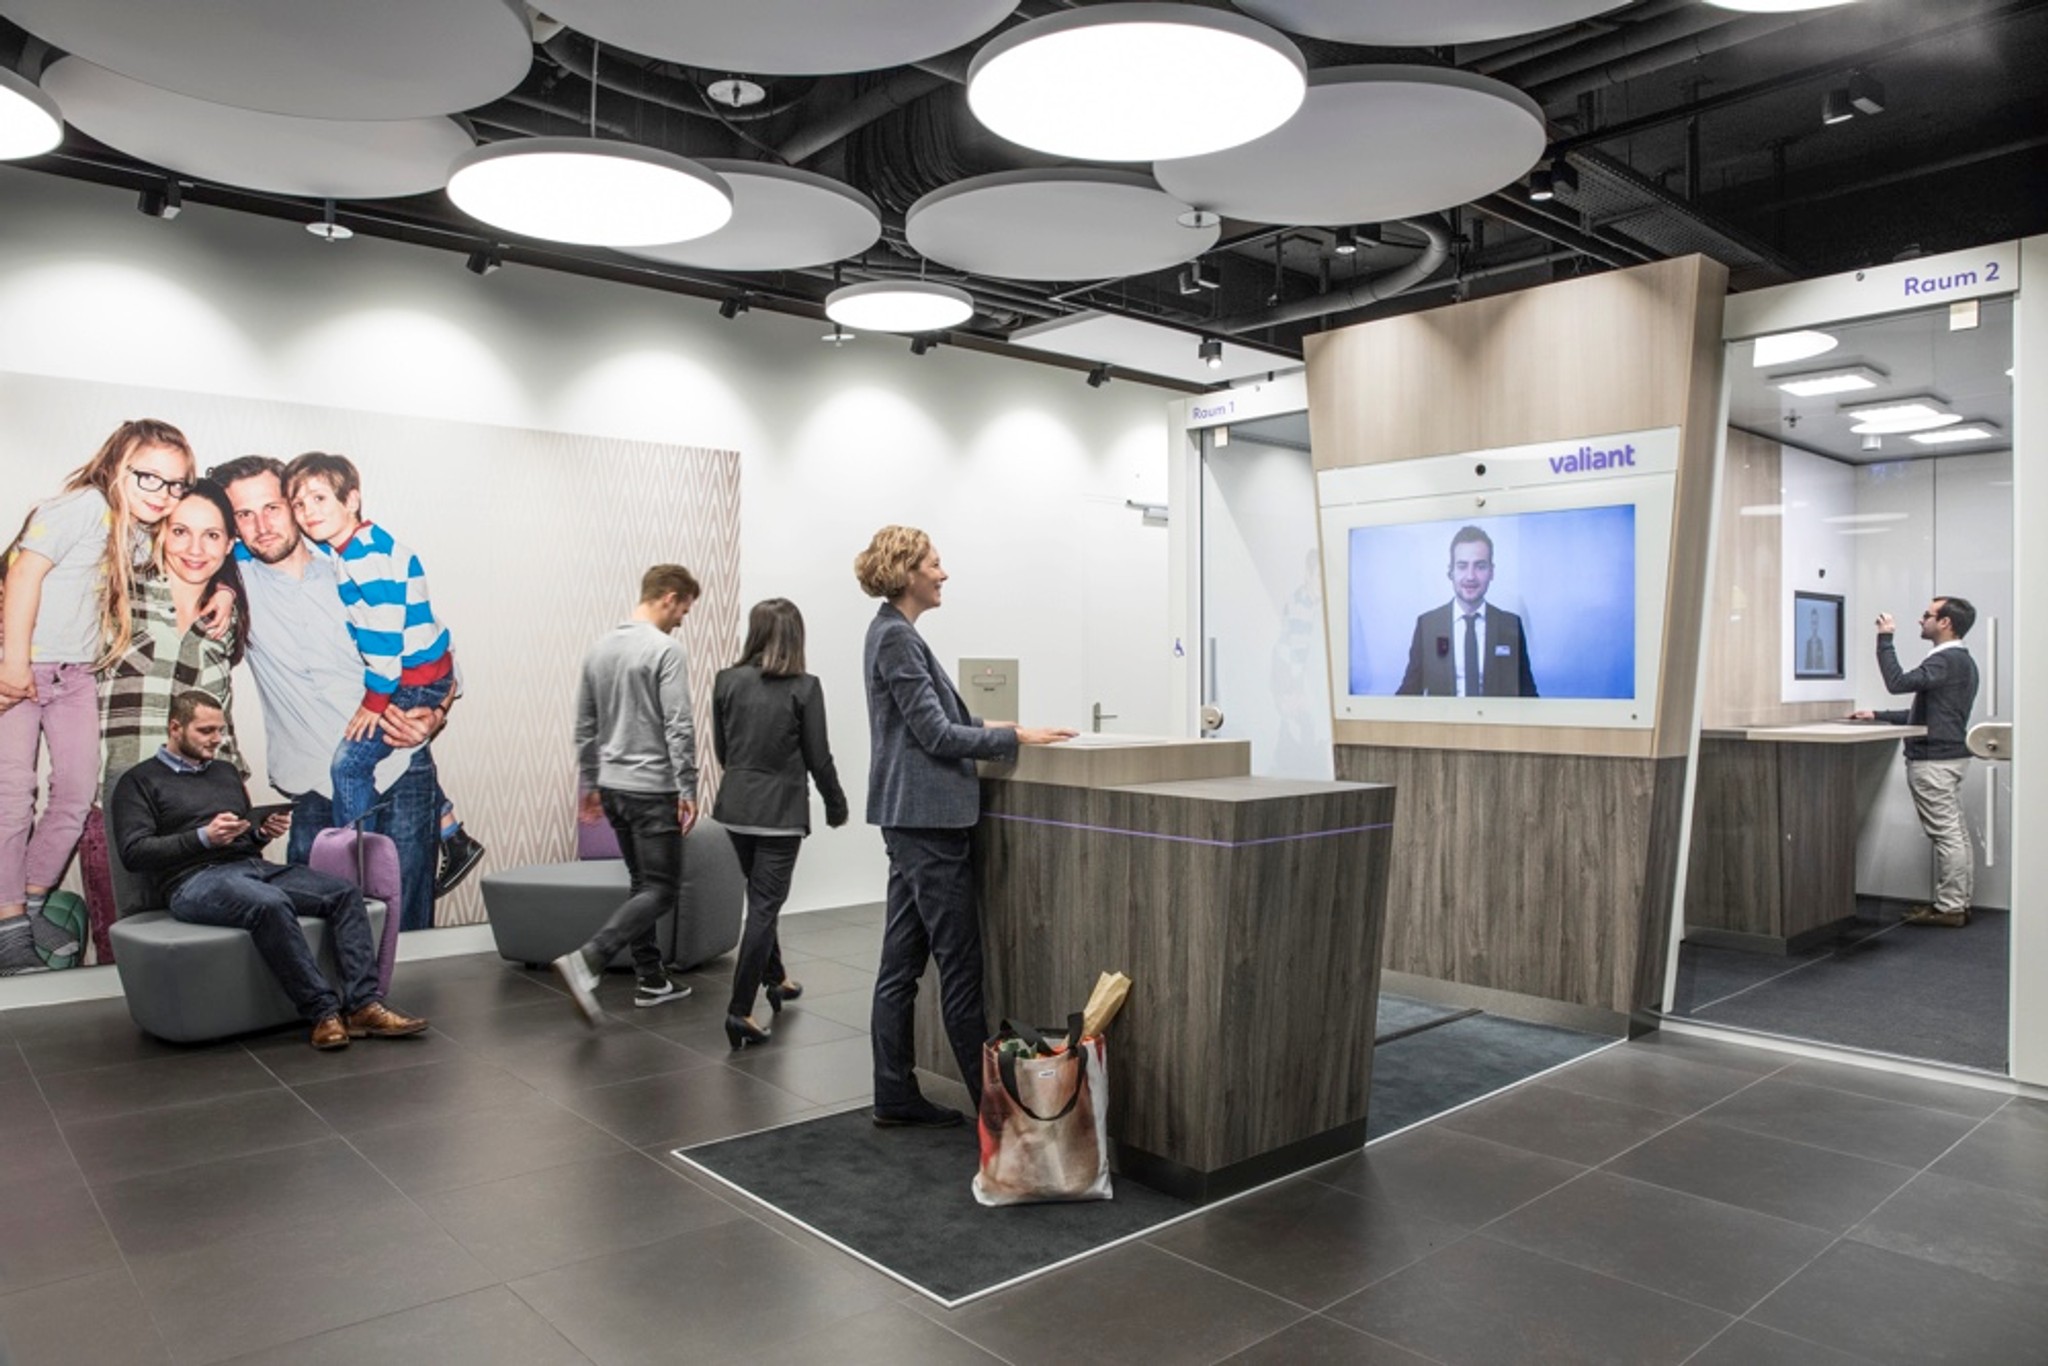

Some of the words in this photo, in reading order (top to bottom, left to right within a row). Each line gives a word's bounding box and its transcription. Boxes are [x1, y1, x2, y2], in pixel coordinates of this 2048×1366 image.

[1904, 271, 1977, 295] Raum
[1985, 262, 2000, 281] 2
[1193, 405, 1226, 419] Raum
[1229, 401, 1235, 413] 1
[1549, 444, 1636, 474] valiant
